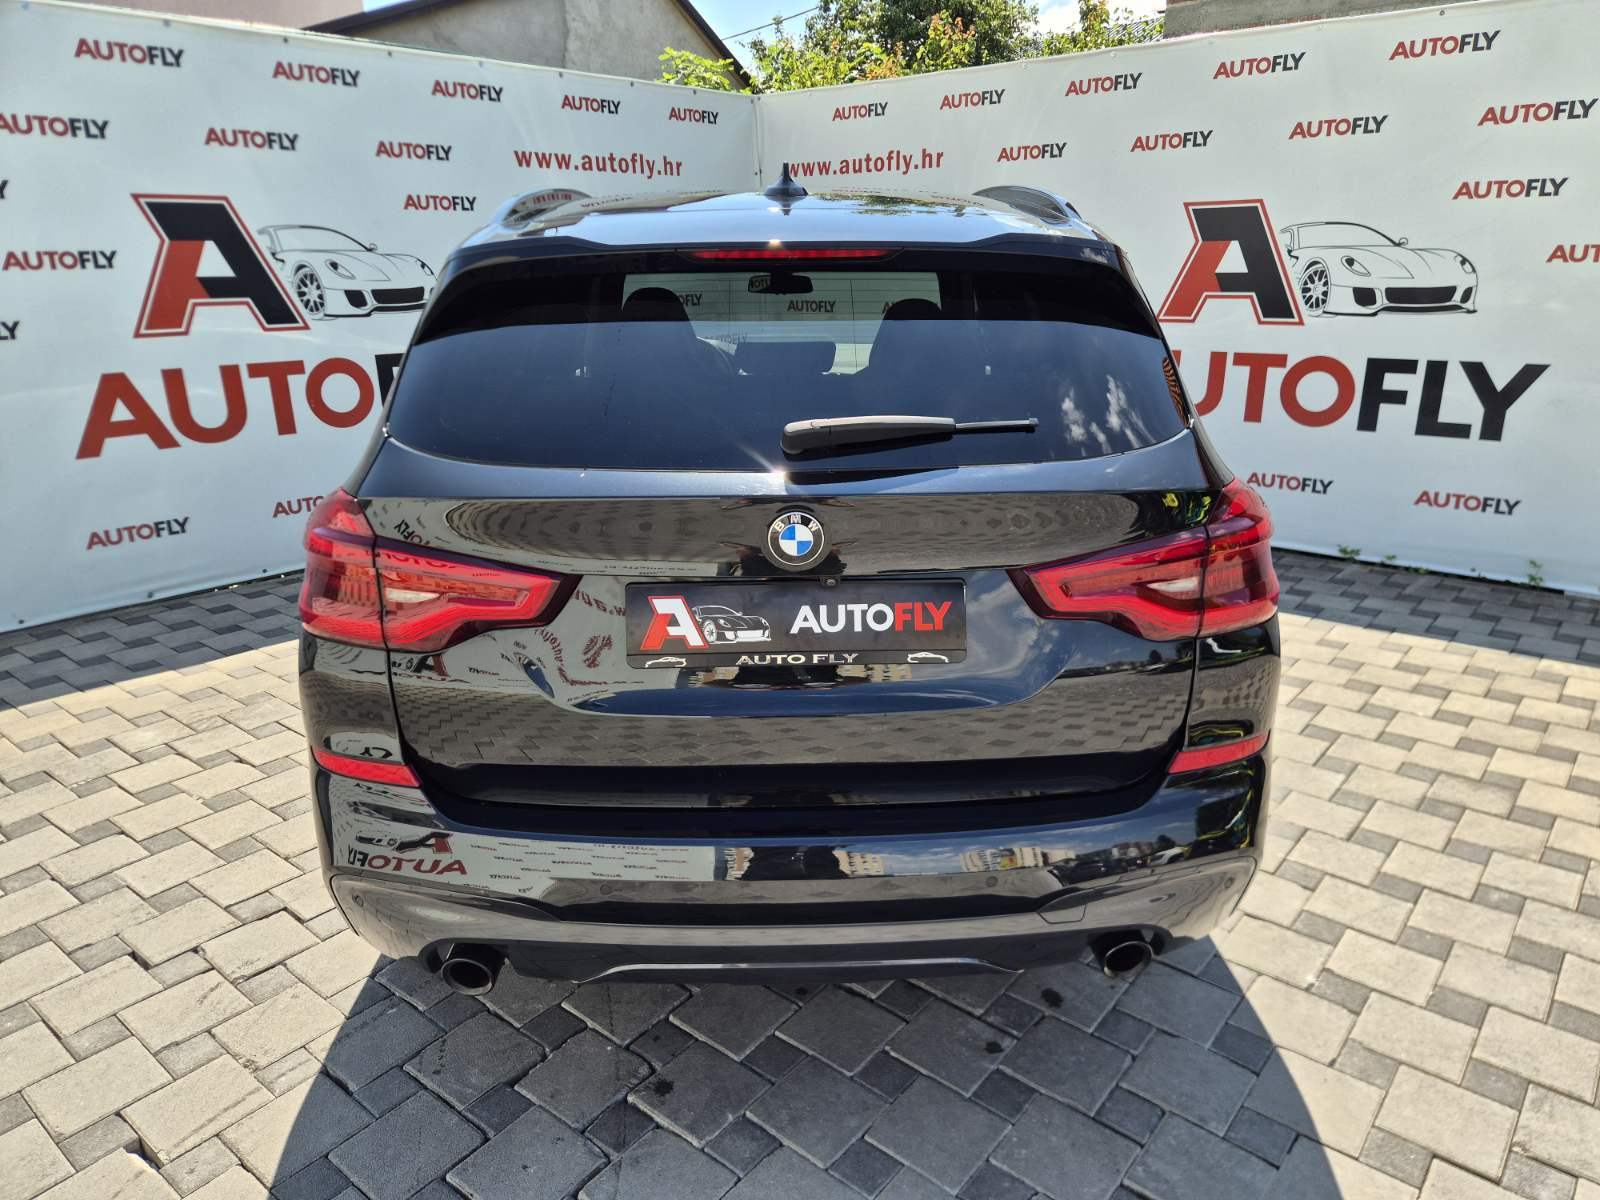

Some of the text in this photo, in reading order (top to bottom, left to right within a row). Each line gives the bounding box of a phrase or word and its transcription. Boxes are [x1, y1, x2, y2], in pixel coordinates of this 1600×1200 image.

[75, 39, 184, 68] AUTOFLY
[1389, 30, 1500, 60] AUTOFLY
[273, 62, 360, 87] AUTOFLY
[1213, 52, 1306, 79] AUTOFLY
[432, 80, 503, 102] AUTOFLY
[1065, 73, 1142, 96] AUTOFLY
[562, 95, 620, 114] AUTOFLY
[940, 89, 1005, 110] AUTOFLY
[669, 107, 718, 125] AUTOFLY
[832, 102, 888, 121] AUTOFLY
[1478, 98, 1598, 126] AUTOFLY
[0, 114, 109, 139] AUTOFLY
[1289, 115, 1388, 139] AUTOFLY
[205, 128, 298, 151] AUTOFLY
[376, 141, 452, 161] AUTOFLY
[1130, 130, 1213, 152] AUTOFLY
[997, 143, 1067, 162] AUTOFLY
[514, 151, 682, 179] www.autofly.hr
[1453, 178, 1568, 200] AUTOFLY
[404, 195, 476, 211] AUTOFLY
[3, 251, 116, 270] AUTOFLY
[131, 193, 311, 338] A
[1157, 199, 1304, 325] A
[787, 300, 836, 313] AUTOFLY
[1244, 472, 1333, 495] AUTOFLY
[1414, 491, 1520, 515] AUTOFLY
[88, 517, 189, 549] AUTOFLY
[773, 514, 820, 532] BMW
[641, 596, 709, 650] A
[790, 601, 952, 634] AUTOFLY
[736, 653, 859, 665] AUTO FLY
